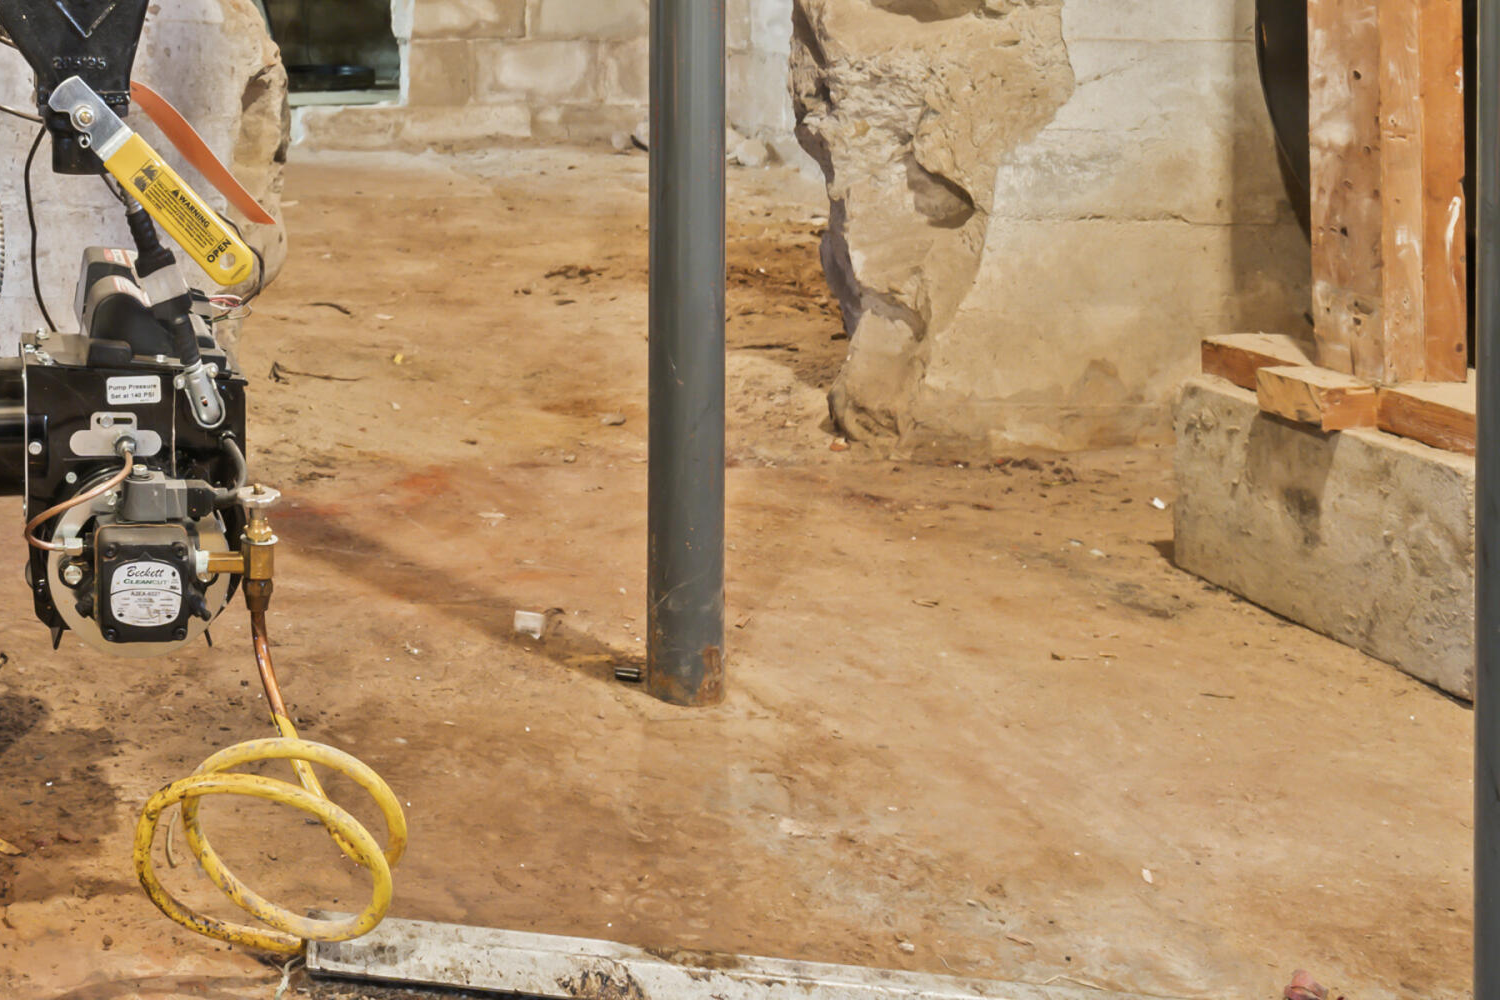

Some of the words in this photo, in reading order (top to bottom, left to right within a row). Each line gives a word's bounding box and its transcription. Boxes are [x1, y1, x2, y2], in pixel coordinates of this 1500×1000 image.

[179, 194, 210, 228] WARNING
[206, 238, 232, 263] OPEN
[126, 565, 165, 578] Beckett
